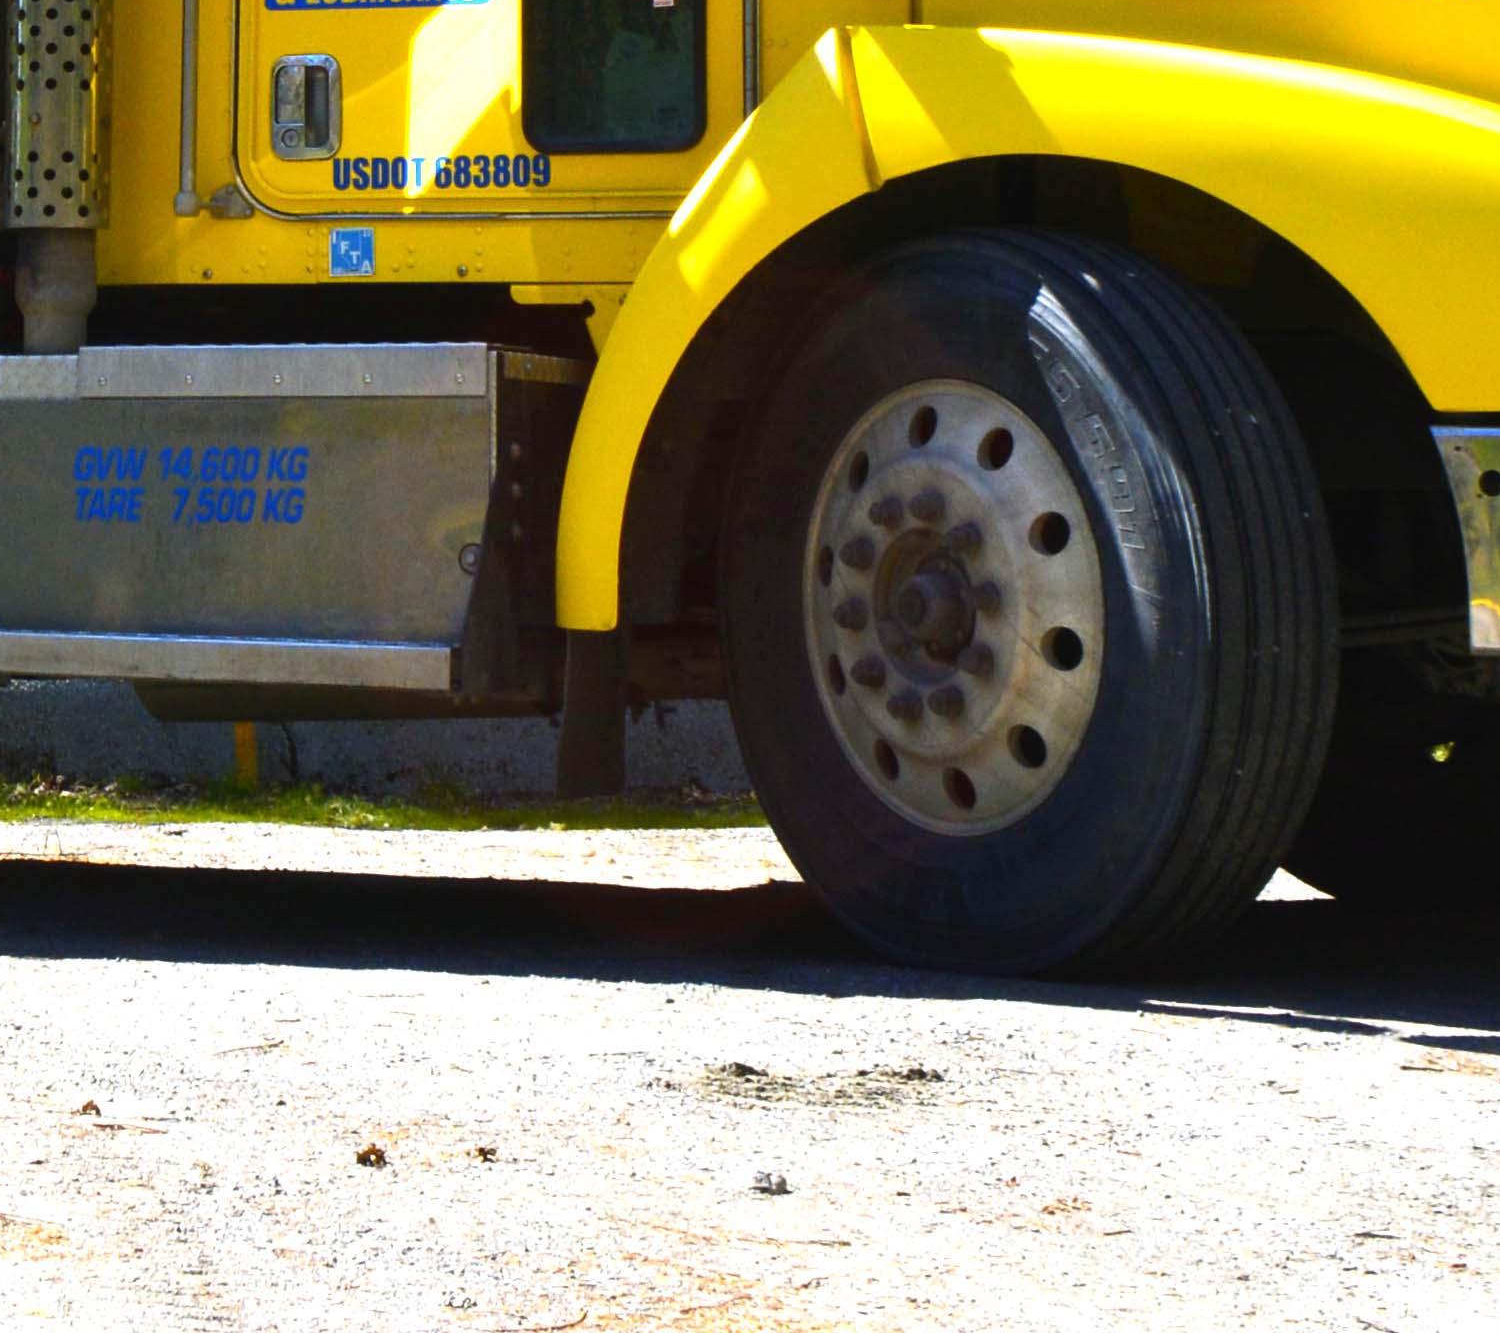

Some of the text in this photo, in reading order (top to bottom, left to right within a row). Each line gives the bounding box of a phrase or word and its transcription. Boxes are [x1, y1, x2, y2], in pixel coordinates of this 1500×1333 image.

[332, 154, 551, 190] USDOT 683809
[73, 445, 309, 485] GVW 14,600 KG
[74, 486, 305, 526] TARE 7,500 KG
